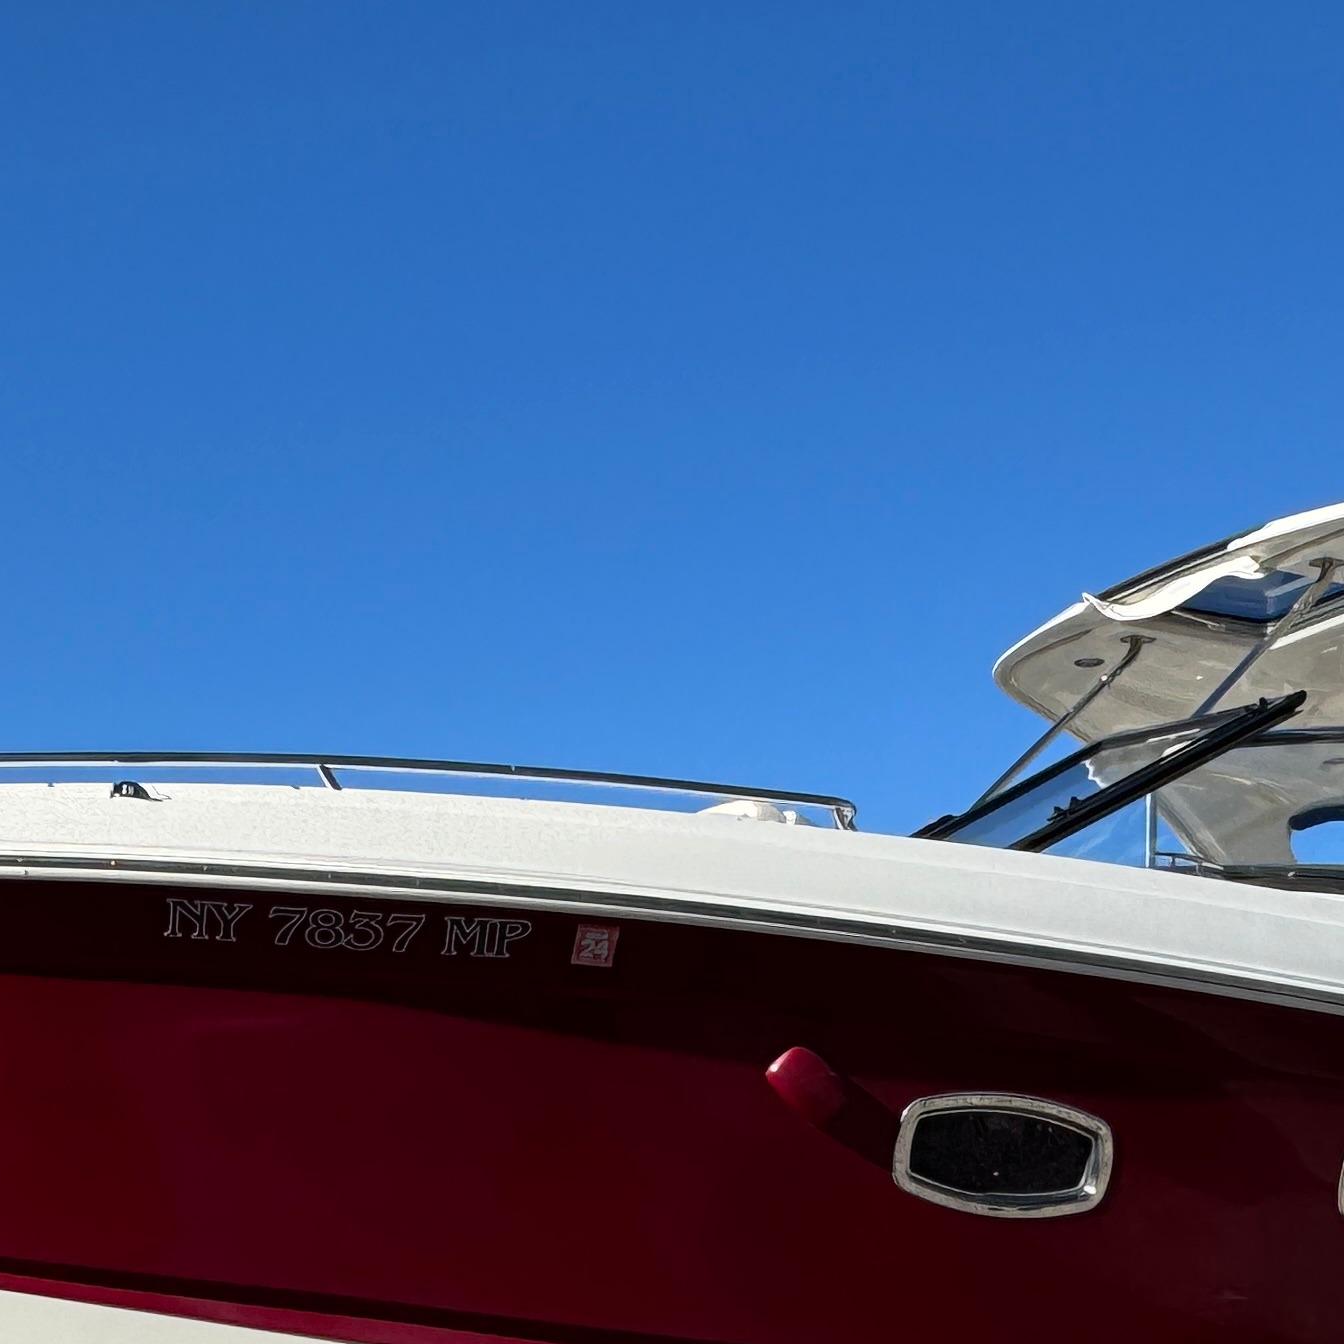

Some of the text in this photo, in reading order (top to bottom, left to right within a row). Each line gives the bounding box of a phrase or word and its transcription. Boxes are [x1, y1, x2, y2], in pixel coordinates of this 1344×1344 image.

[163, 897, 533, 958] NY 7837 MP
[579, 938, 609, 962] 24
